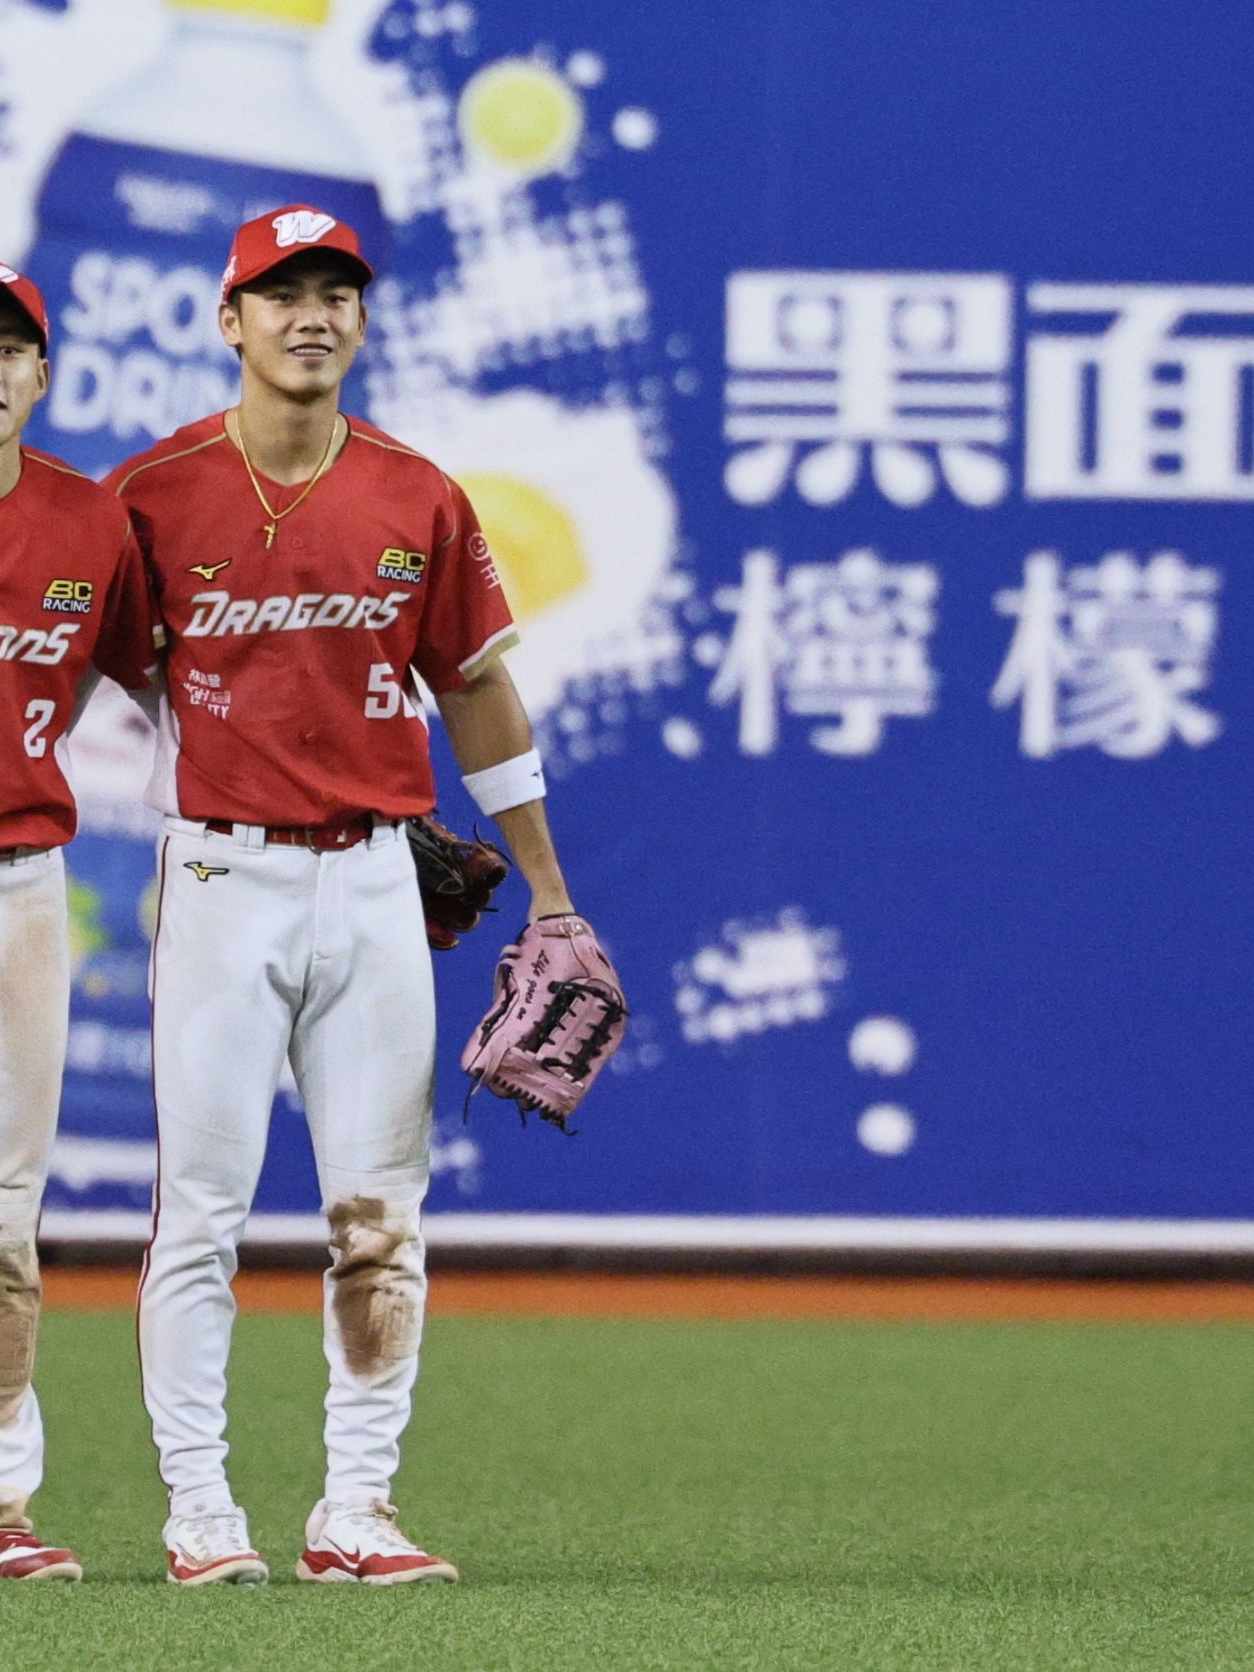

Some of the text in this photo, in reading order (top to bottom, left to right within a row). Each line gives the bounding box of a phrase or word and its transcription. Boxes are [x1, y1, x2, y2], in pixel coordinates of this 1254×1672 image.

[61, 252, 240, 356] SPO
[724, 270, 1254, 508] 黑面
[377, 565, 422, 583] RACING
[378, 547, 426, 571] BC
[42, 597, 91, 613] RACING
[43, 579, 93, 601] BC
[709, 550, 1221, 758] 檸檬
[23, 699, 56, 758] 2
